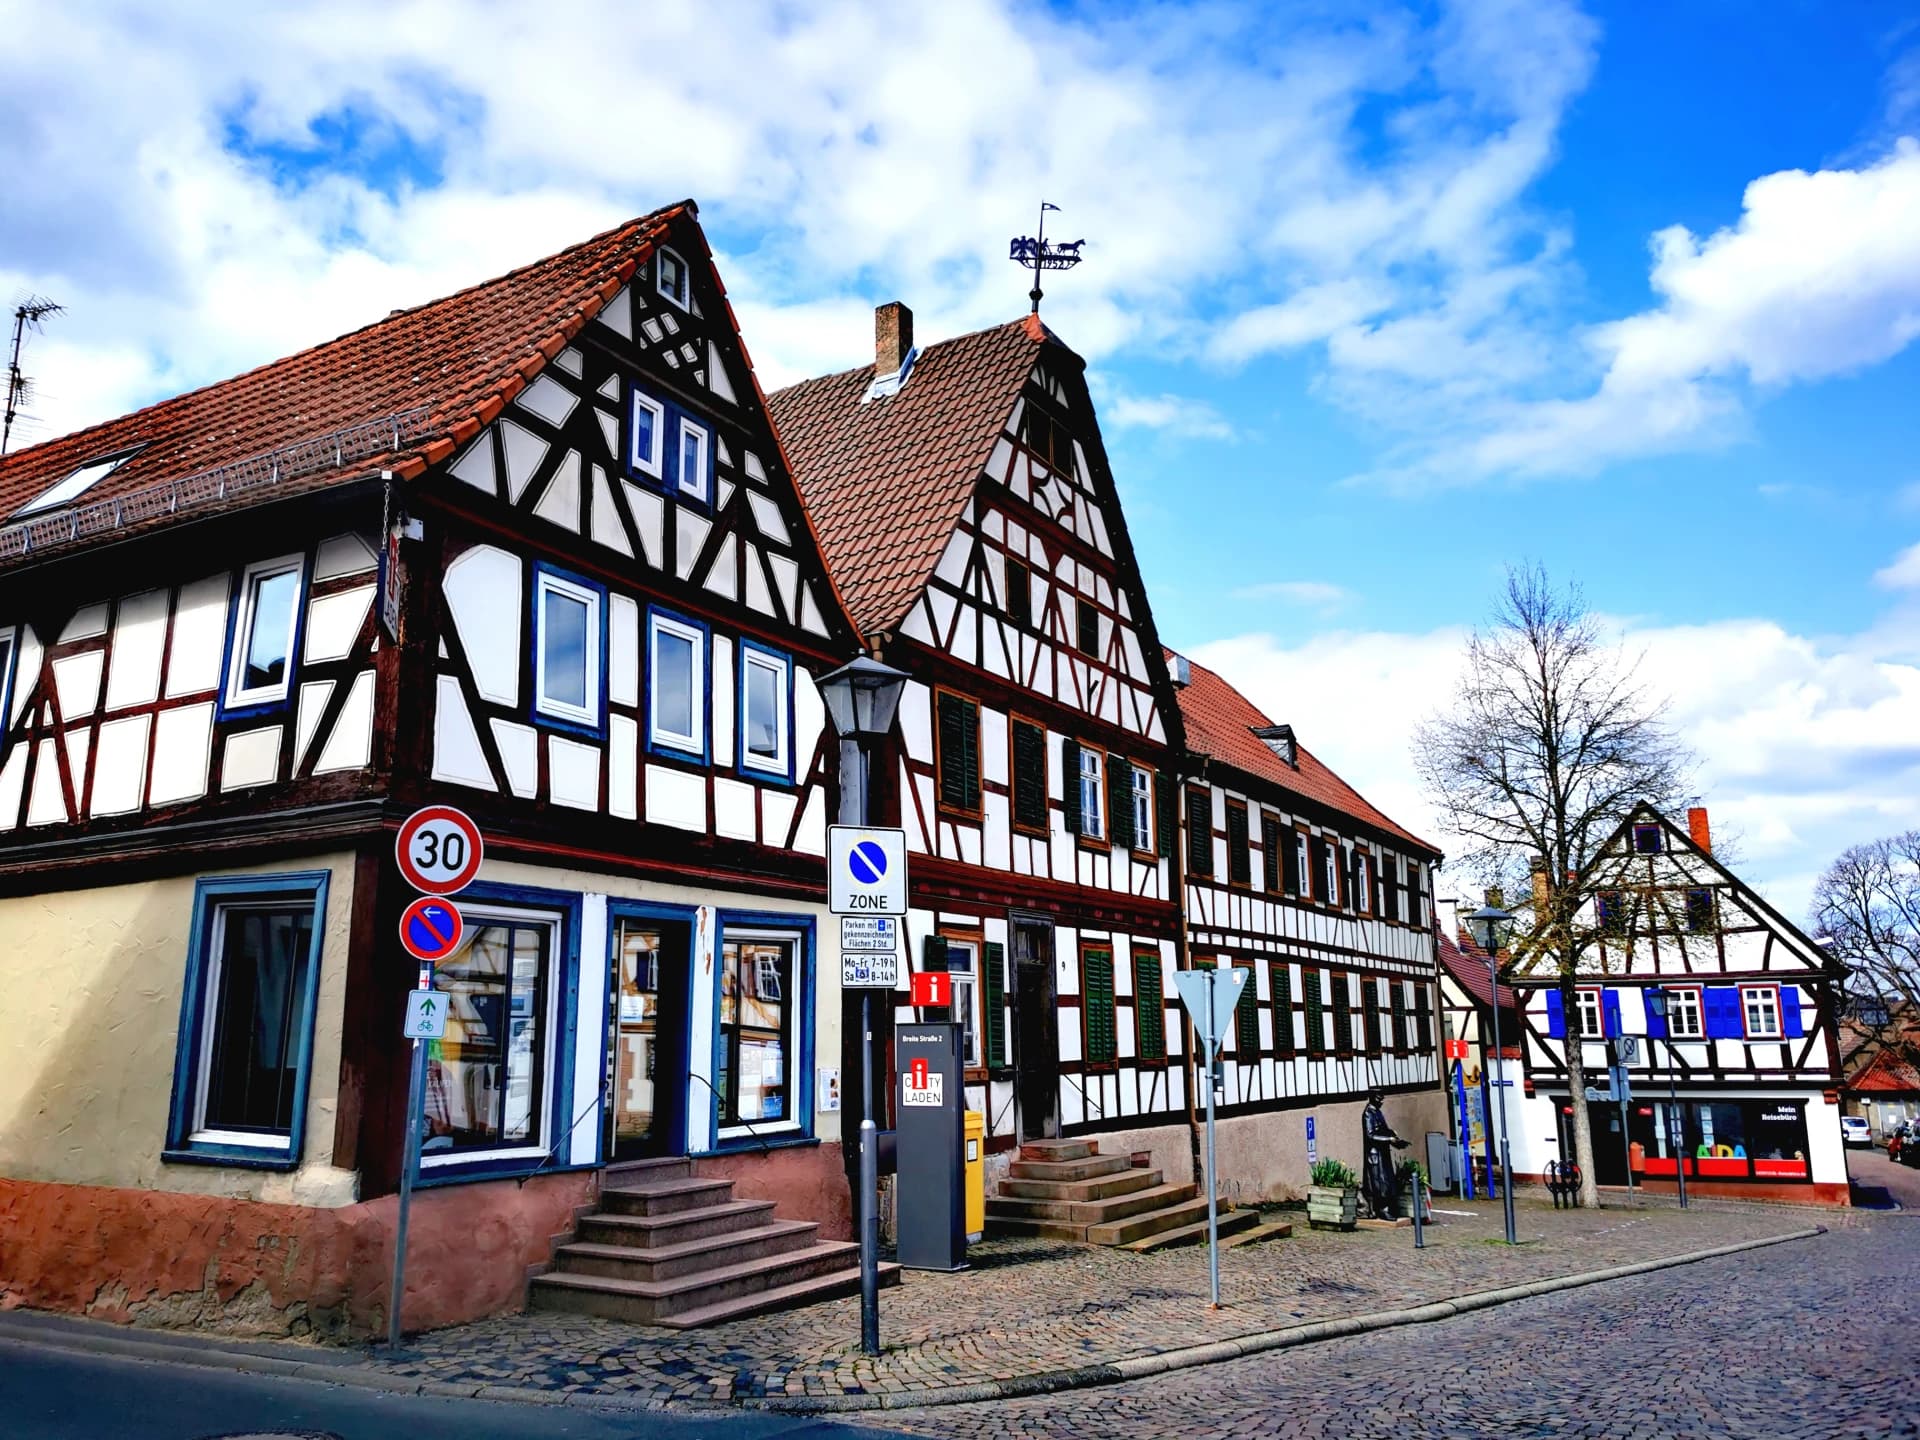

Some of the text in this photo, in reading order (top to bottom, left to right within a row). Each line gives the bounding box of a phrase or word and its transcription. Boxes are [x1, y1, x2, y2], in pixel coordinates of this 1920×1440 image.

[416, 830, 464, 871] 30
[849, 894, 888, 909] ZONE
[845, 920, 866, 929] Parken
[867, 921, 877, 929] mit
[849, 938, 872, 948] Flächen
[872, 939, 877, 948] 2
[844, 957, 895, 968] Mo-Fr 7-19 h
[844, 971, 895, 982] Sa 8-14 h
[938, 1034, 943, 1042] 2
[904, 1092, 942, 1103] LADEN
[1697, 1144, 1747, 1158] AIDA
